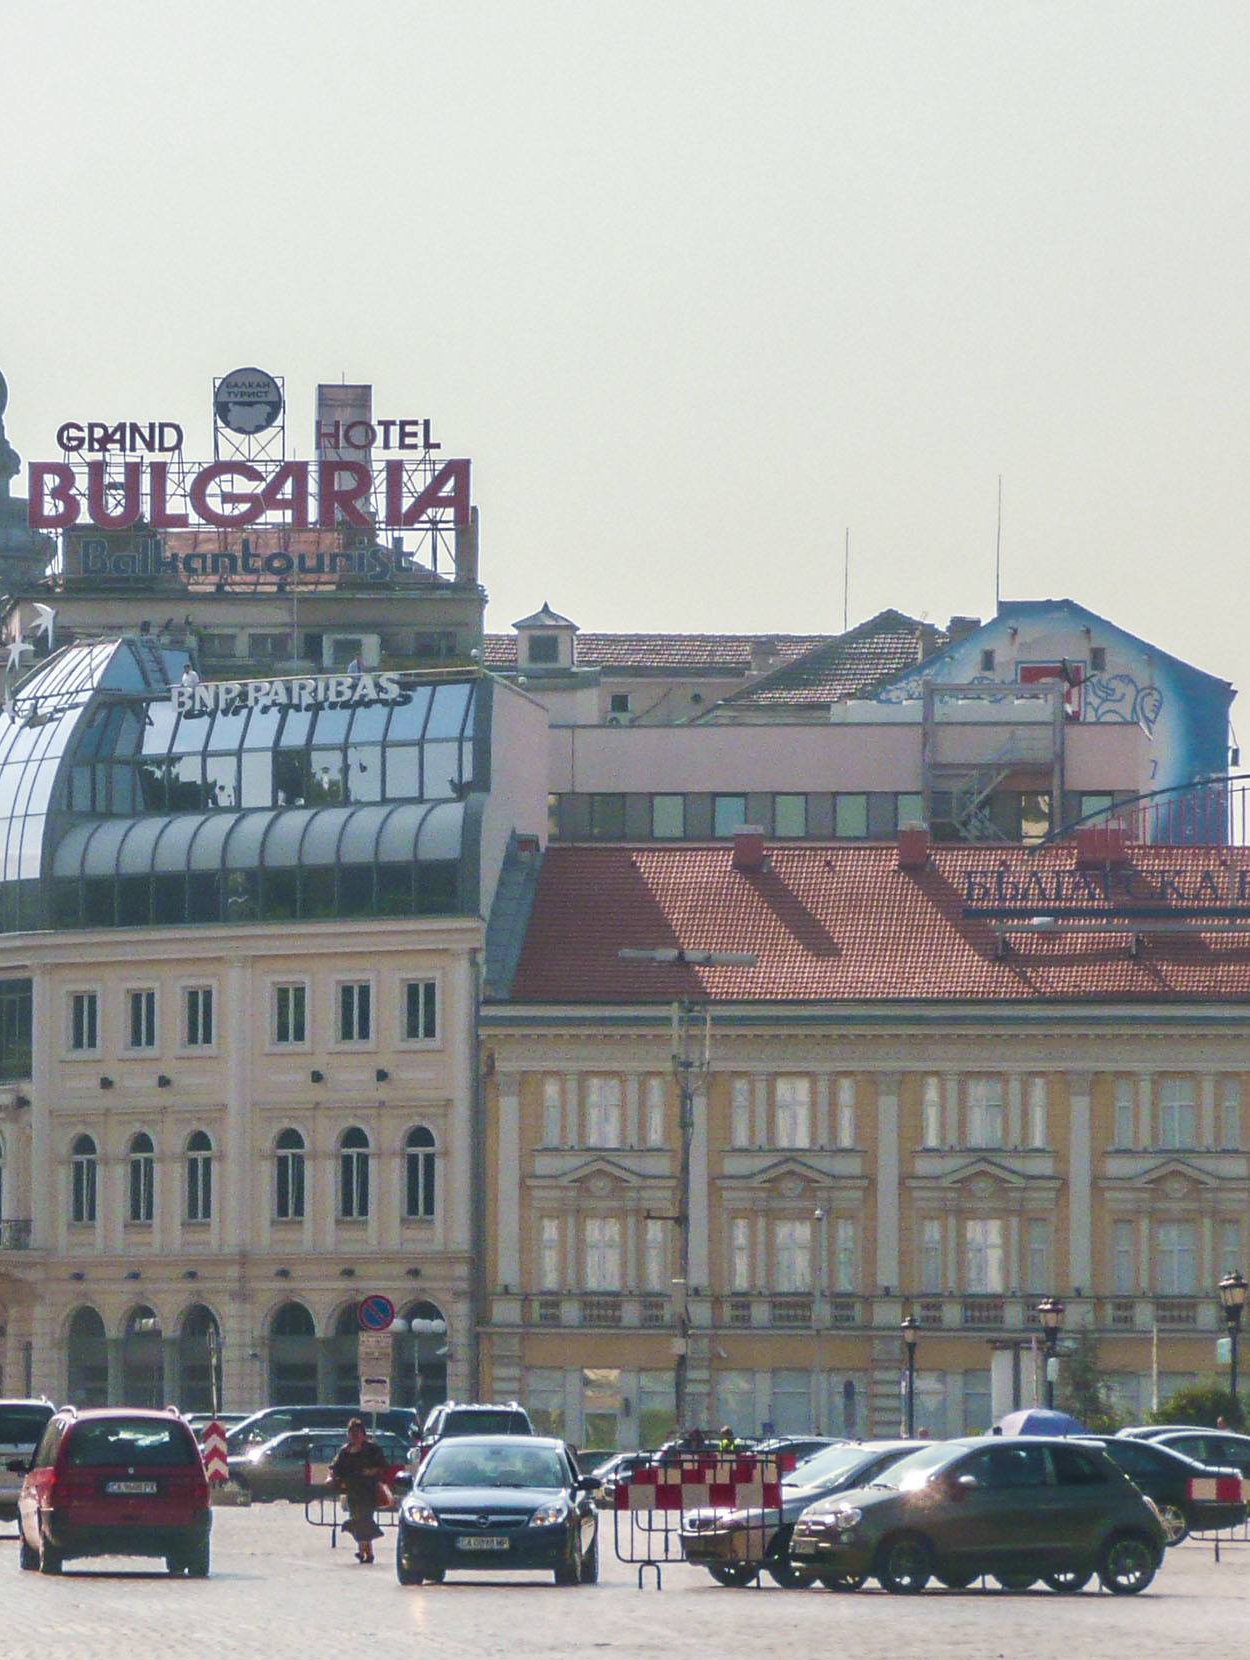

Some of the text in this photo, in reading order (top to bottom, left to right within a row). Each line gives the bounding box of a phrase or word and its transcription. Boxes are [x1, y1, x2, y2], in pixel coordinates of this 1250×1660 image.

[226, 390, 269, 398] ТУРИСТ
[56, 419, 441, 452] GRAND HOTEL
[28, 458, 472, 529] BULGARIA
[80, 536, 415, 581] Balkantourist
[171, 671, 401, 713] BNP PARIBAS
